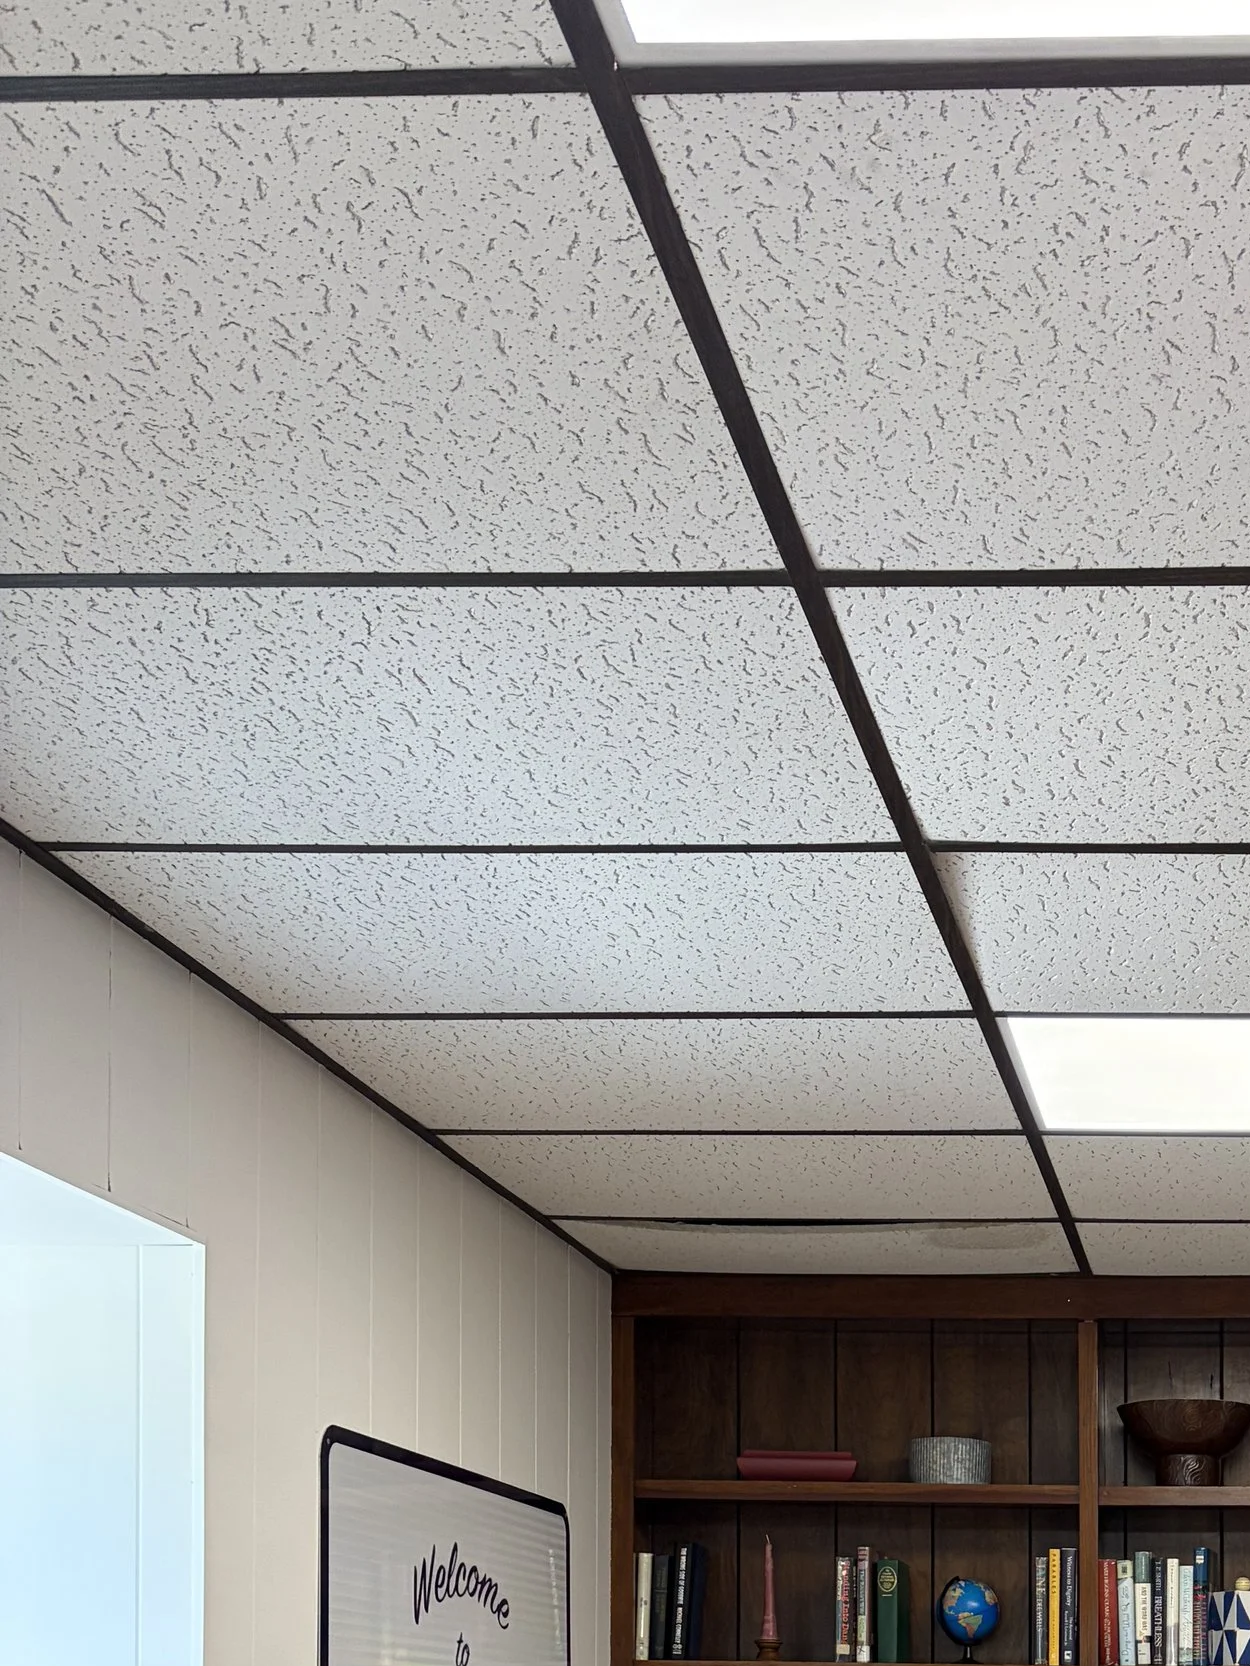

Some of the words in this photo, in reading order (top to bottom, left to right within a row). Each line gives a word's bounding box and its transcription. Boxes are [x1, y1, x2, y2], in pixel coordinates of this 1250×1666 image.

[412, 1542, 510, 1629] Welcome
[1065, 1585, 1073, 1606] Dignity
[1153, 1595, 1163, 1647] BREATHLESS
